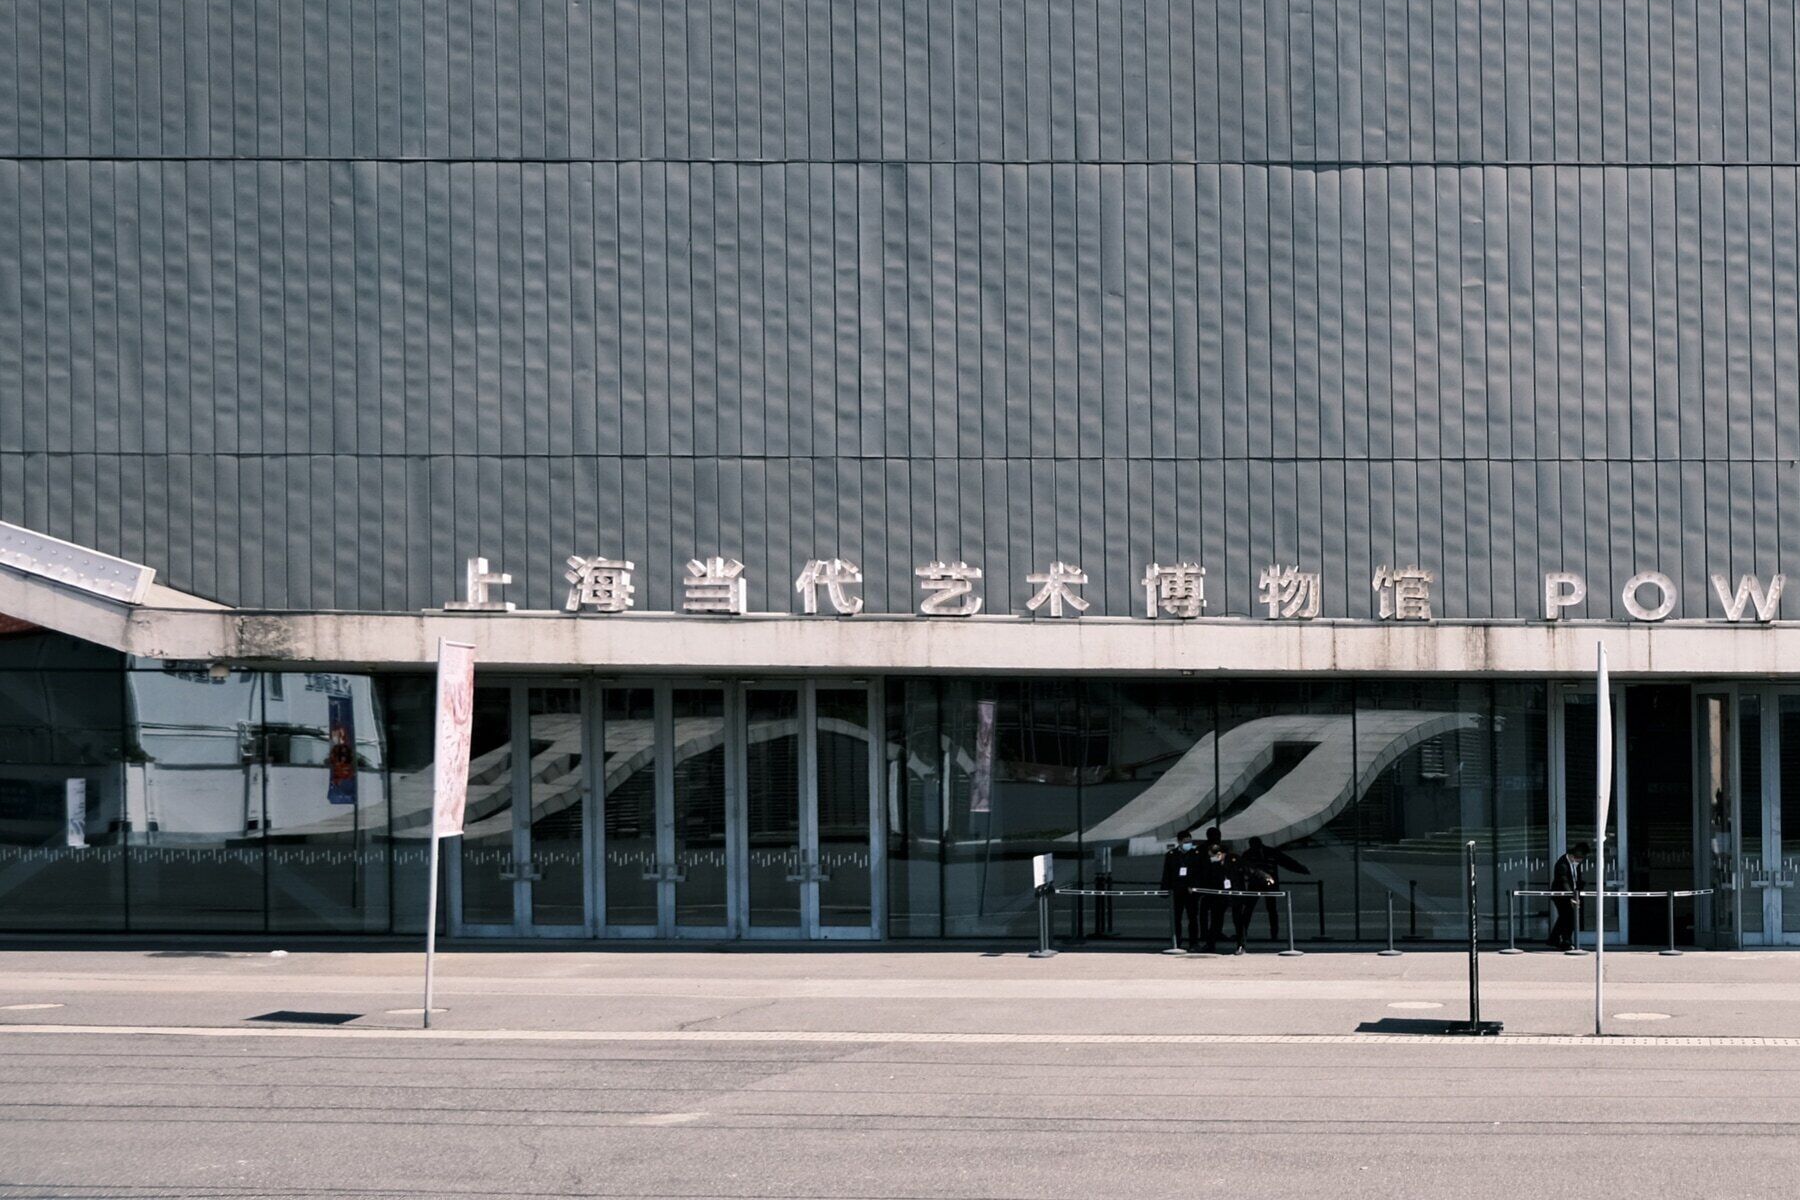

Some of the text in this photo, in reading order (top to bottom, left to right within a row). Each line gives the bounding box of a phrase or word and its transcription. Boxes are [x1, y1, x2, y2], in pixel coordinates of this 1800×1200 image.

[443, 555, 1433, 621] 上海当代艺术博物馆
